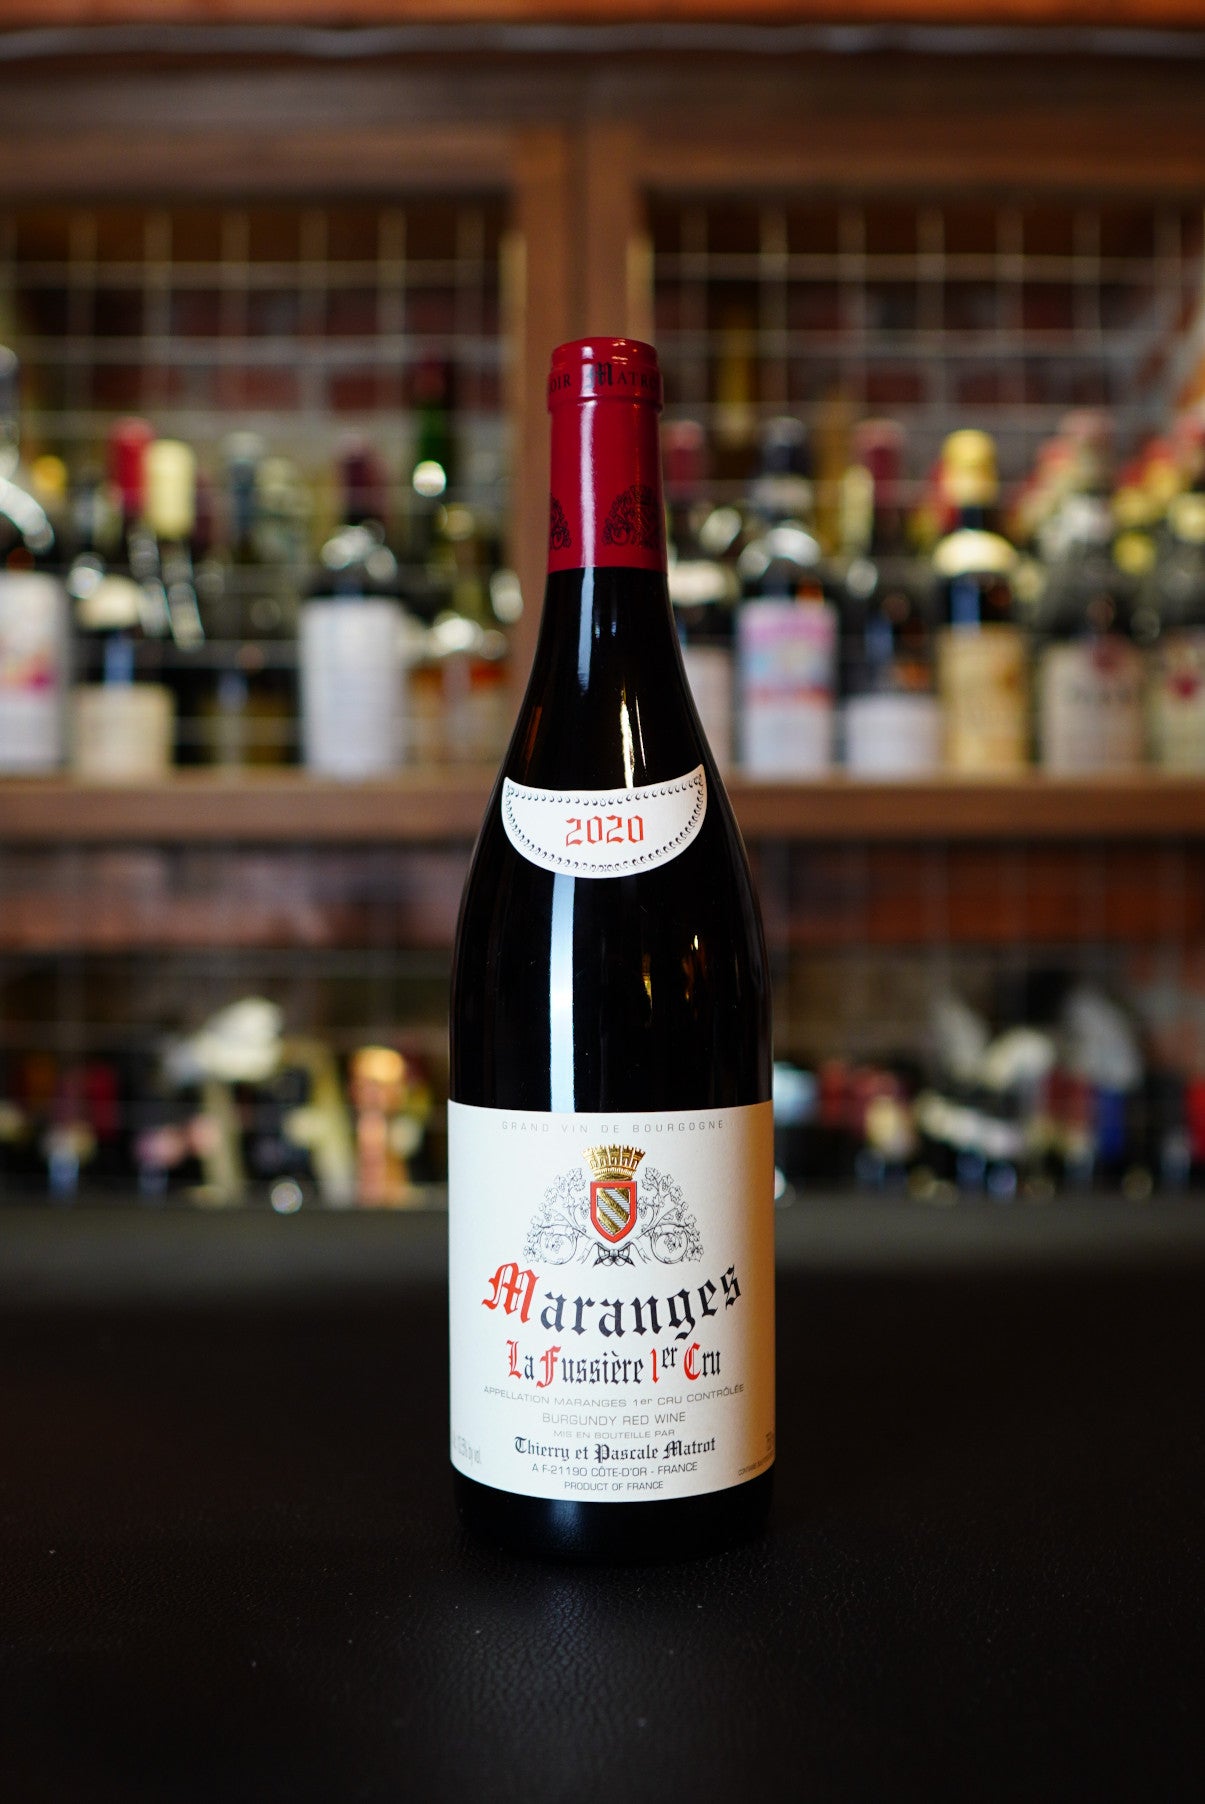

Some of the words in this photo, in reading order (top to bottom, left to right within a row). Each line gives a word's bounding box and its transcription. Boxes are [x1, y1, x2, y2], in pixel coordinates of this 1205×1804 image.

[566, 815, 644, 847] 2020
[502, 1120, 550, 1132] GRAND
[562, 1123, 588, 1133] VIN
[601, 1124, 620, 1133] DE
[633, 1119, 724, 1133] BOURGOGNE
[481, 1262, 742, 1340] Maranges
[506, 1340, 534, 1380] La
[536, 1345, 644, 1388] Fussière
[650, 1345, 677, 1384] 1er
[683, 1342, 721, 1380] Cru
[484, 1386, 550, 1404] APPELLATION
[554, 1397, 627, 1408] MARANGES
[633, 1398, 653, 1407] 1er
[657, 1396, 683, 1406] CRU
[686, 1383, 744, 1403] CONTRÔLÉE
[542, 1412, 617, 1426] BURGUNDY
[622, 1415, 649, 1426] RED
[654, 1411, 687, 1424] WINE
[553, 1430, 573, 1438] MIS
[576, 1431, 591, 1439] EN
[594, 1431, 652, 1440] BOUTEILLE
[654, 1429, 675, 1437] PAR
[514, 1436, 570, 1462] Thierry
[575, 1446, 589, 1460] et
[594, 1443, 659, 1464] Pascale
[662, 1437, 716, 1460] Matrot
[532, 1463, 539, 1472] A
[542, 1464, 588, 1477] F-21190
[591, 1465, 647, 1478] CÔTE-D'OR
[657, 1462, 698, 1476] FRANCE
[564, 1481, 609, 1491] PRODUCT
[611, 1483, 624, 1492] OF
[627, 1481, 664, 1490] FRANCE
